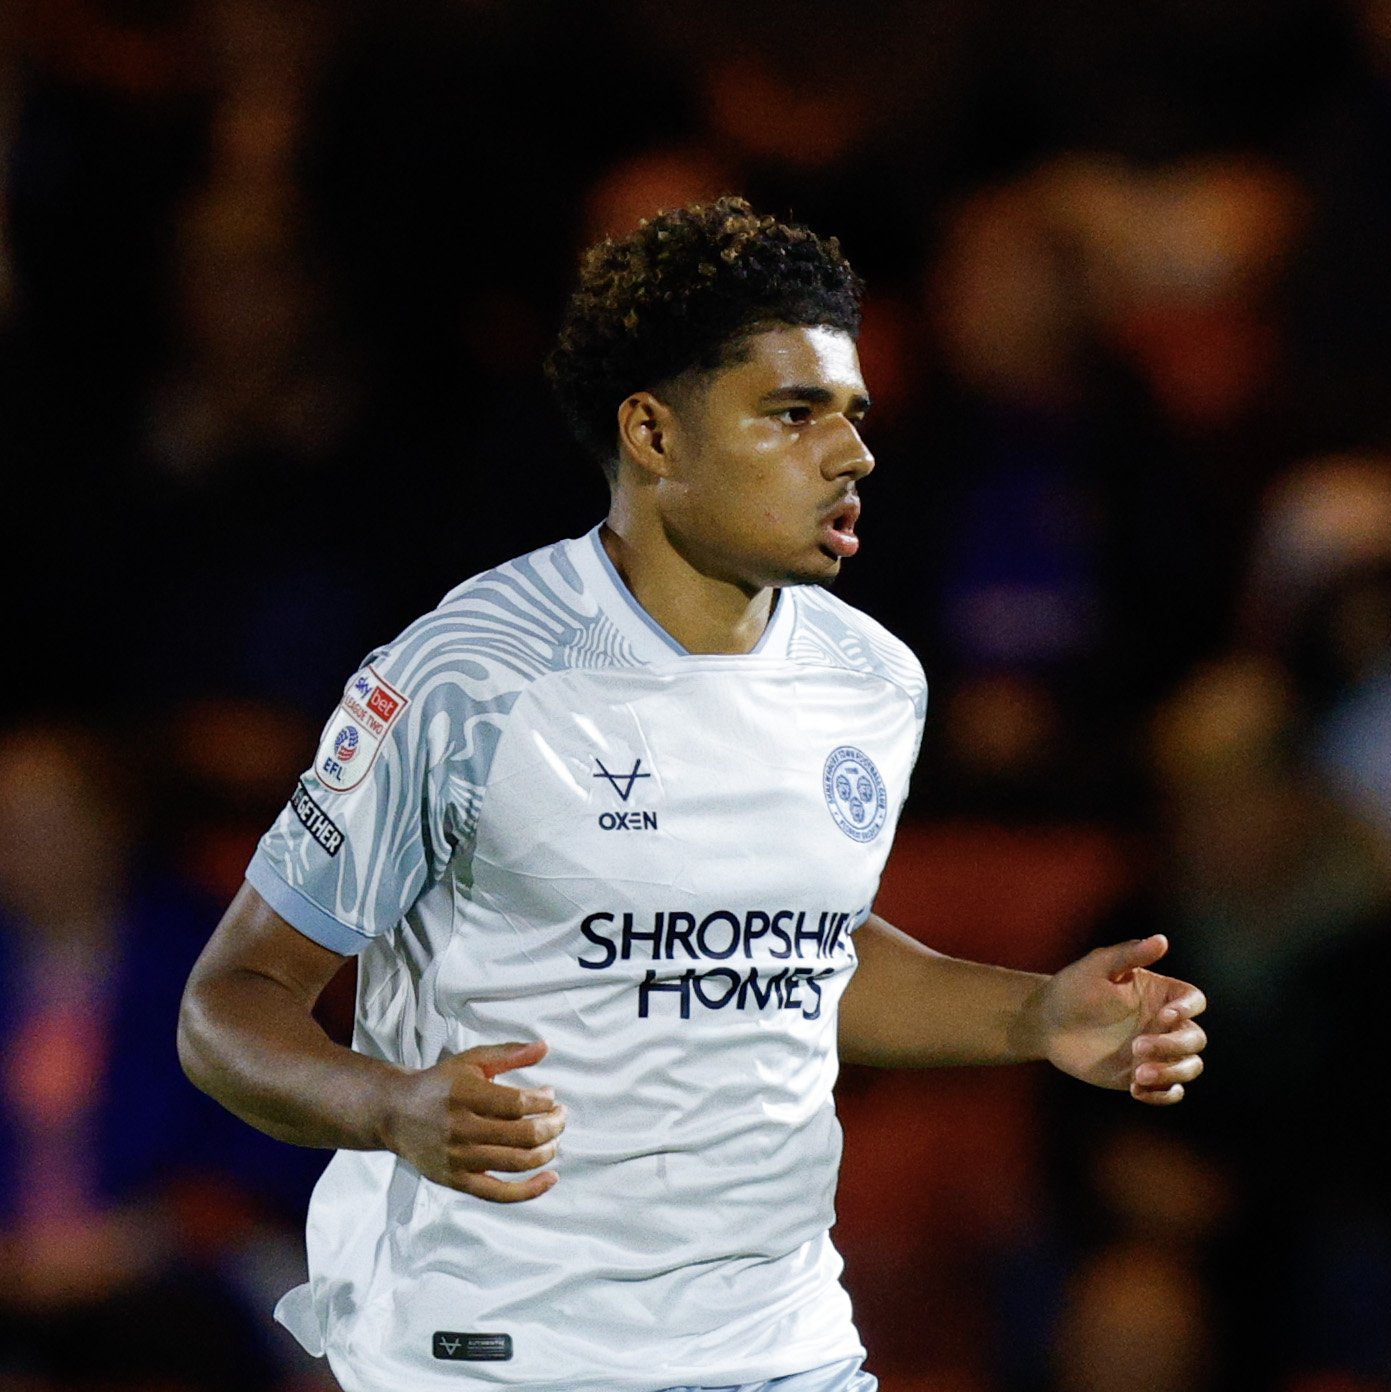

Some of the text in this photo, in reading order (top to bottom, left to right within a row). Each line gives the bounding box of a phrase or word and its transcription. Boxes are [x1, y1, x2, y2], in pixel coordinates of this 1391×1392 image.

[344, 694, 384, 735] LEAGUE TWO
[371, 688, 394, 717] bet
[323, 757, 342, 781] EFL
[598, 811, 658, 831] OXEN
[577, 910, 855, 970] SHROPSHI
[638, 967, 835, 1020] HOMES
